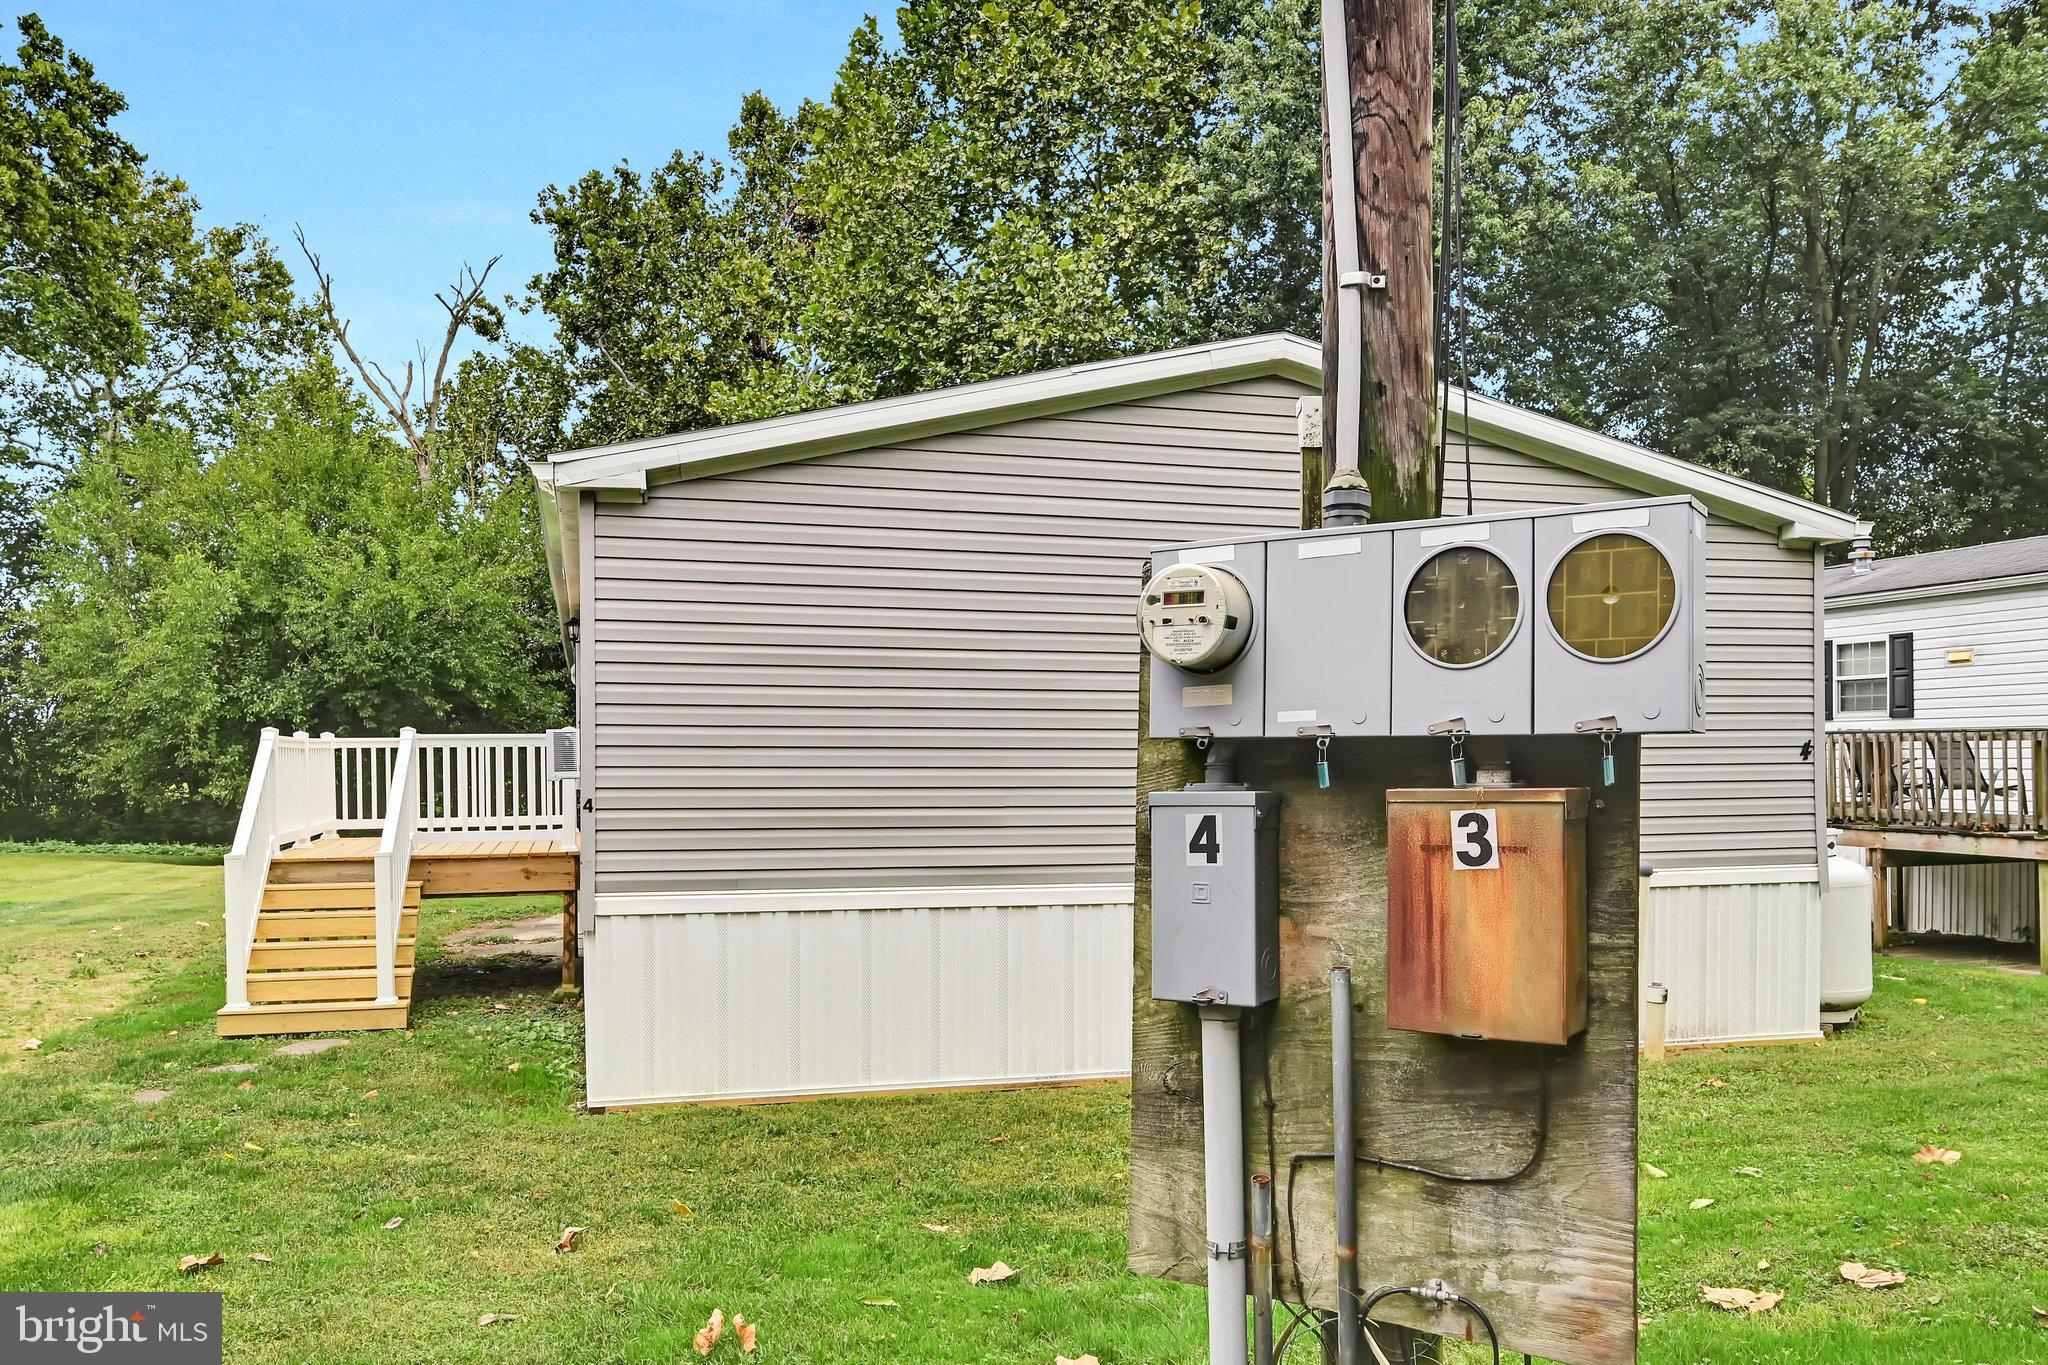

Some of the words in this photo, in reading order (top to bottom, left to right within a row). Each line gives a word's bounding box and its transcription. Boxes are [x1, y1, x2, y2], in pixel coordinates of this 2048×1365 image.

[1800, 739, 1812, 761] 4
[582, 797, 594, 813] 4
[1189, 815, 1220, 864] 4
[1456, 812, 1493, 867] 3
